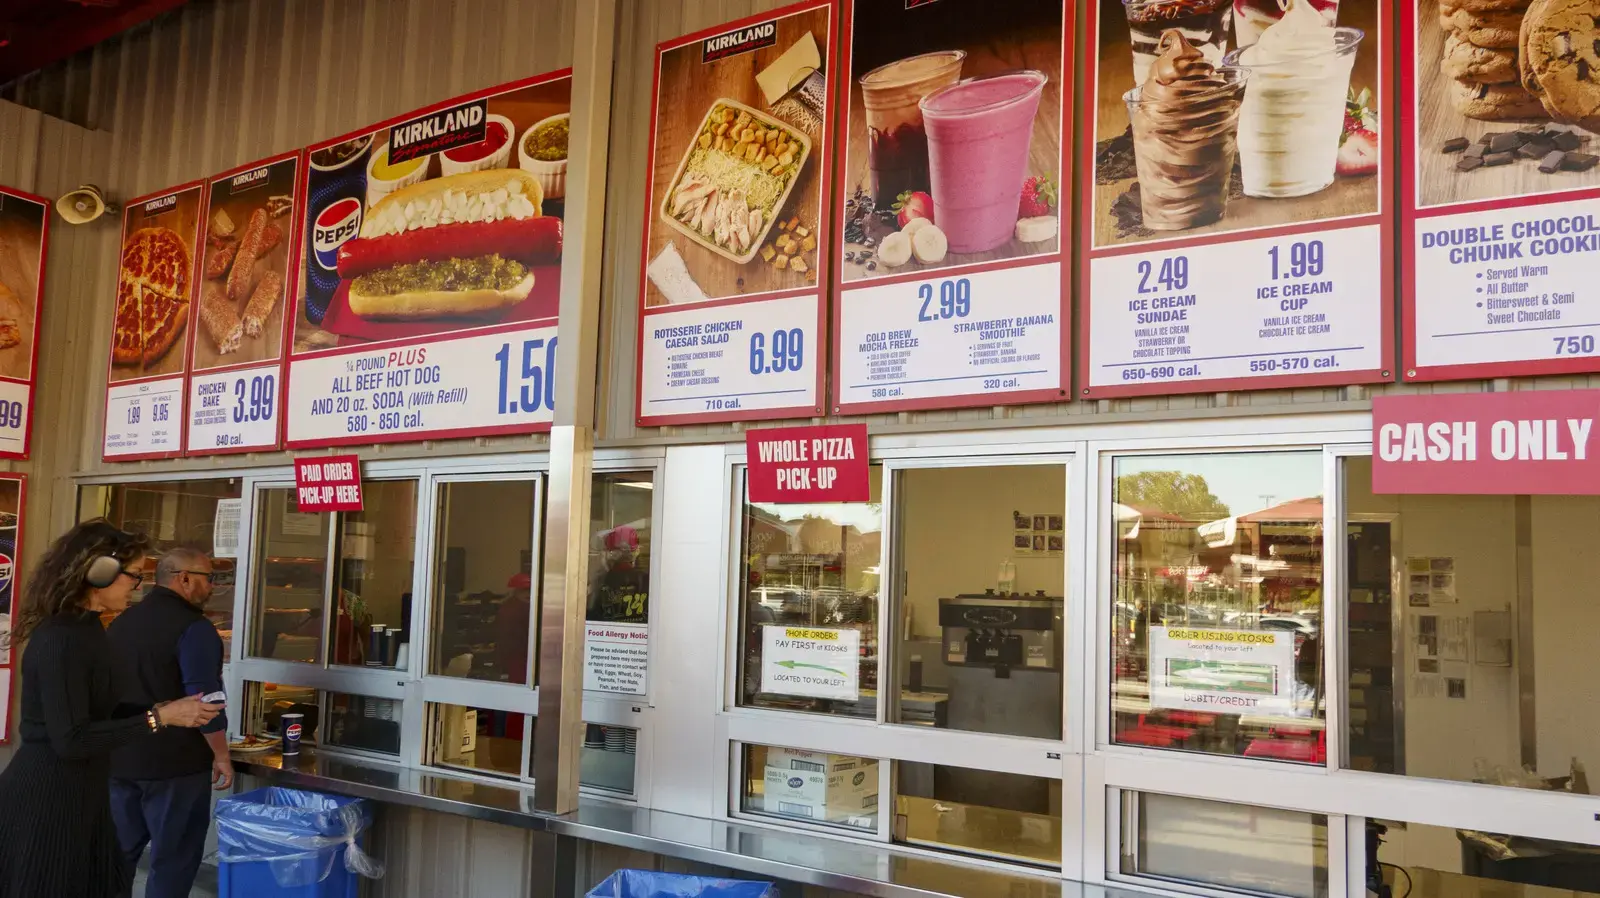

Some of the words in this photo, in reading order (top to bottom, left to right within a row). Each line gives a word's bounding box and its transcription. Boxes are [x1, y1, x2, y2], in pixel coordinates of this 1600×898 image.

[706, 23, 774, 52] KIRKLAND
[393, 105, 482, 148] KIRKLAND
[233, 168, 268, 186] KIRKLAND
[145, 195, 176, 211] KIRKLAND
[315, 215, 359, 244] PEPSI
[1422, 224, 1504, 248] DOUBLE
[1450, 242, 1523, 264] CHUNK
[1530, 234, 1600, 257] COOKI
[1268, 240, 1324, 281] 1.99
[1137, 255, 1188, 294] 2.49
[1487, 266, 1518, 280] Served
[1521, 265, 1548, 277] Warm
[1257, 287, 1278, 299] ICE
[1283, 281, 1333, 296] CREAM
[1487, 284, 1498, 295] All
[1501, 282, 1529, 294] Butter
[918, 278, 971, 322] 2.99
[1129, 299, 1148, 312] ICE
[1152, 295, 1196, 309] CREAM
[1280, 298, 1308, 311] CUP
[1487, 295, 1539, 310] Bittersweet
[1542, 294, 1549, 305] &
[1552, 292, 1574, 305] Semi
[954, 318, 1013, 333] STRAWBERRY
[1016, 314, 1054, 327] BANANA
[1137, 310, 1187, 324] SUNDAE
[1264, 316, 1289, 327] VANILLA
[1291, 315, 1301, 324] ICE
[1303, 314, 1325, 323] CREAM
[1487, 312, 1515, 325] Sweet
[1517, 309, 1561, 323] Chocolate
[654, 325, 702, 339] ROTISSERIE
[704, 320, 743, 333] CHICKEN
[866, 332, 886, 342] COLD
[888, 329, 912, 340] BREW
[980, 327, 1025, 340] SMOOTHIE
[1135, 328, 1157, 337] VANILLA
[1159, 327, 1168, 335] ICE
[1170, 325, 1189, 334] CREAM
[1259, 327, 1294, 338] CHOCOLATE
[1296, 326, 1306, 335] ICE
[1308, 324, 1330, 334] CREAM
[666, 336, 698, 348] CAESAR
[701, 333, 729, 345] SALAD
[859, 342, 887, 352] MOCHA
[890, 338, 919, 349] FREEZE
[1138, 337, 1176, 347] STRAWBERRY
[1178, 336, 1185, 344] OR
[1553, 335, 1594, 355] 750
[356, 356, 385, 371] POUND
[388, 348, 426, 367] PLUS
[750, 328, 803, 375] 6.99
[1133, 348, 1164, 358] CHOCOLATE
[1166, 346, 1191, 355] TOPPING
[1250, 357, 1309, 372] 550-570
[1314, 355, 1339, 369] cal.
[332, 377, 352, 394] ALL
[356, 373, 383, 391] BEEF
[387, 369, 410, 388] HOT
[415, 366, 440, 384] DOG
[1122, 365, 1174, 381] 650-690
[1178, 364, 1201, 378] cal.
[198, 382, 226, 395] CHICKEN
[872, 388, 886, 397] 580
[889, 387, 904, 397] cal.
[984, 379, 1000, 389] 320
[1003, 378, 1020, 388] cal.
[203, 395, 220, 407] BAKE
[233, 375, 274, 423] 3.99
[311, 398, 333, 415] AND
[336, 396, 349, 413] 20
[353, 400, 368, 411] oz.
[373, 391, 404, 409] SODA
[408, 390, 434, 409] (With
[437, 387, 468, 404] Refill)
[706, 400, 722, 410] 710
[724, 398, 741, 409] cal.
[128, 407, 140, 424] 1.99
[153, 404, 168, 422] 9.95
[347, 415, 367, 432] 580
[379, 413, 400, 430] 850
[403, 411, 424, 428] cal.
[216, 435, 228, 446] 840
[230, 433, 243, 445] cal.
[1380, 421, 1476, 462] CASH
[1491, 419, 1593, 460] ONLY
[758, 439, 808, 463] WHOLE
[812, 437, 855, 461] PIZZA
[301, 464, 321, 482] PAID
[324, 462, 353, 481] ORDER
[776, 467, 837, 490] PICK-UP
[299, 486, 334, 504] PICK-UP
[336, 485, 360, 503] HERE
[606, 631, 628, 639] Allergy
[810, 631, 838, 640] ORDERS
[1168, 630, 1198, 639] ORDER
[1201, 631, 1234, 641] USING
[1237, 634, 1274, 643] KIOSKS
[776, 640, 789, 648] PAY
[792, 641, 815, 649] FIRST
[1188, 642, 1213, 650] Located
[774, 675, 800, 683] LOCATED
[1184, 693, 1258, 707] DEBIT/CREDIT
